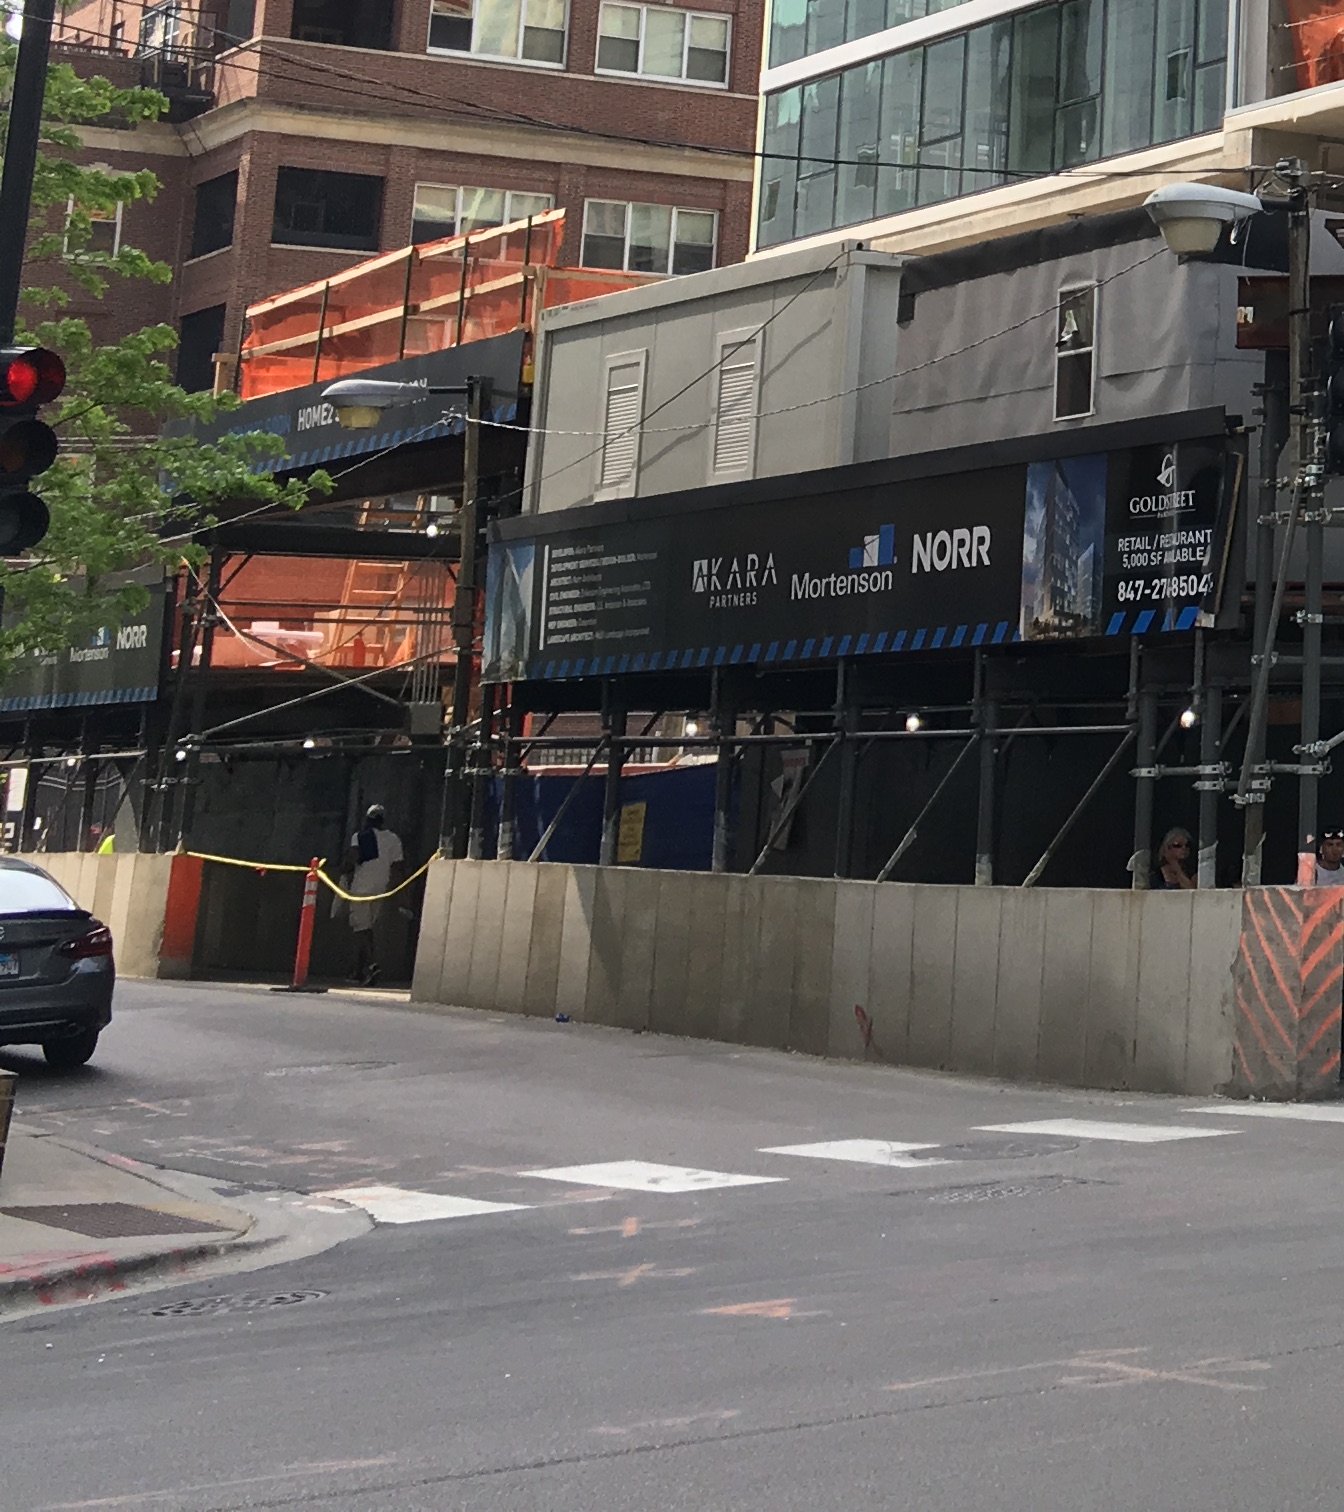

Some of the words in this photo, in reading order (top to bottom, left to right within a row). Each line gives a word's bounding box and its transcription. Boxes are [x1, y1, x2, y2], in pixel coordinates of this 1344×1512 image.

[297, 403, 334, 432] HOME2
[911, 525, 992, 574] NORR
[1117, 534, 1152, 553] RETAIL
[1122, 551, 1149, 569] 5,000
[1149, 550, 1163, 567] SF
[790, 569, 894, 600] Mortenson
[709, 591, 758, 609] PARTNERS
[116, 624, 148, 651] NORR
